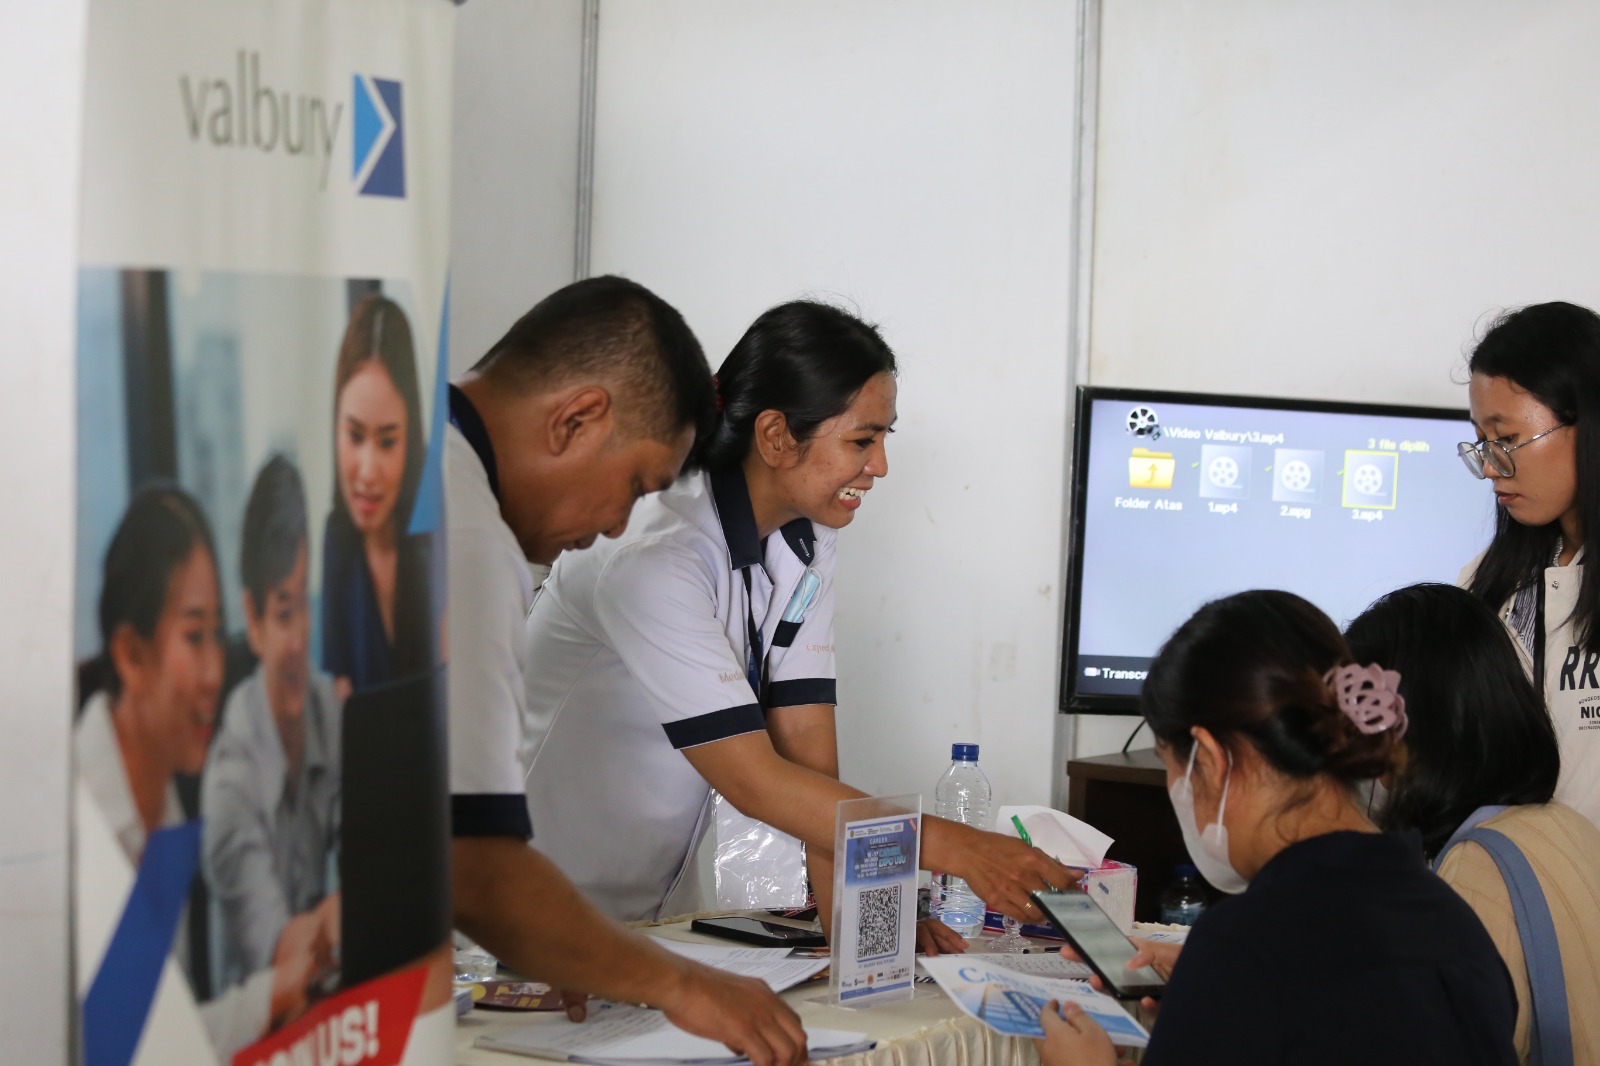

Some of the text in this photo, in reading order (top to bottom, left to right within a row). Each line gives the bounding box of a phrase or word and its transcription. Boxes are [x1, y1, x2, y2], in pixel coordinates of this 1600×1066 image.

[178, 47, 343, 193] valbury
[1368, 438, 1376, 449] 3
[1115, 497, 1183, 511] Folder Atas
